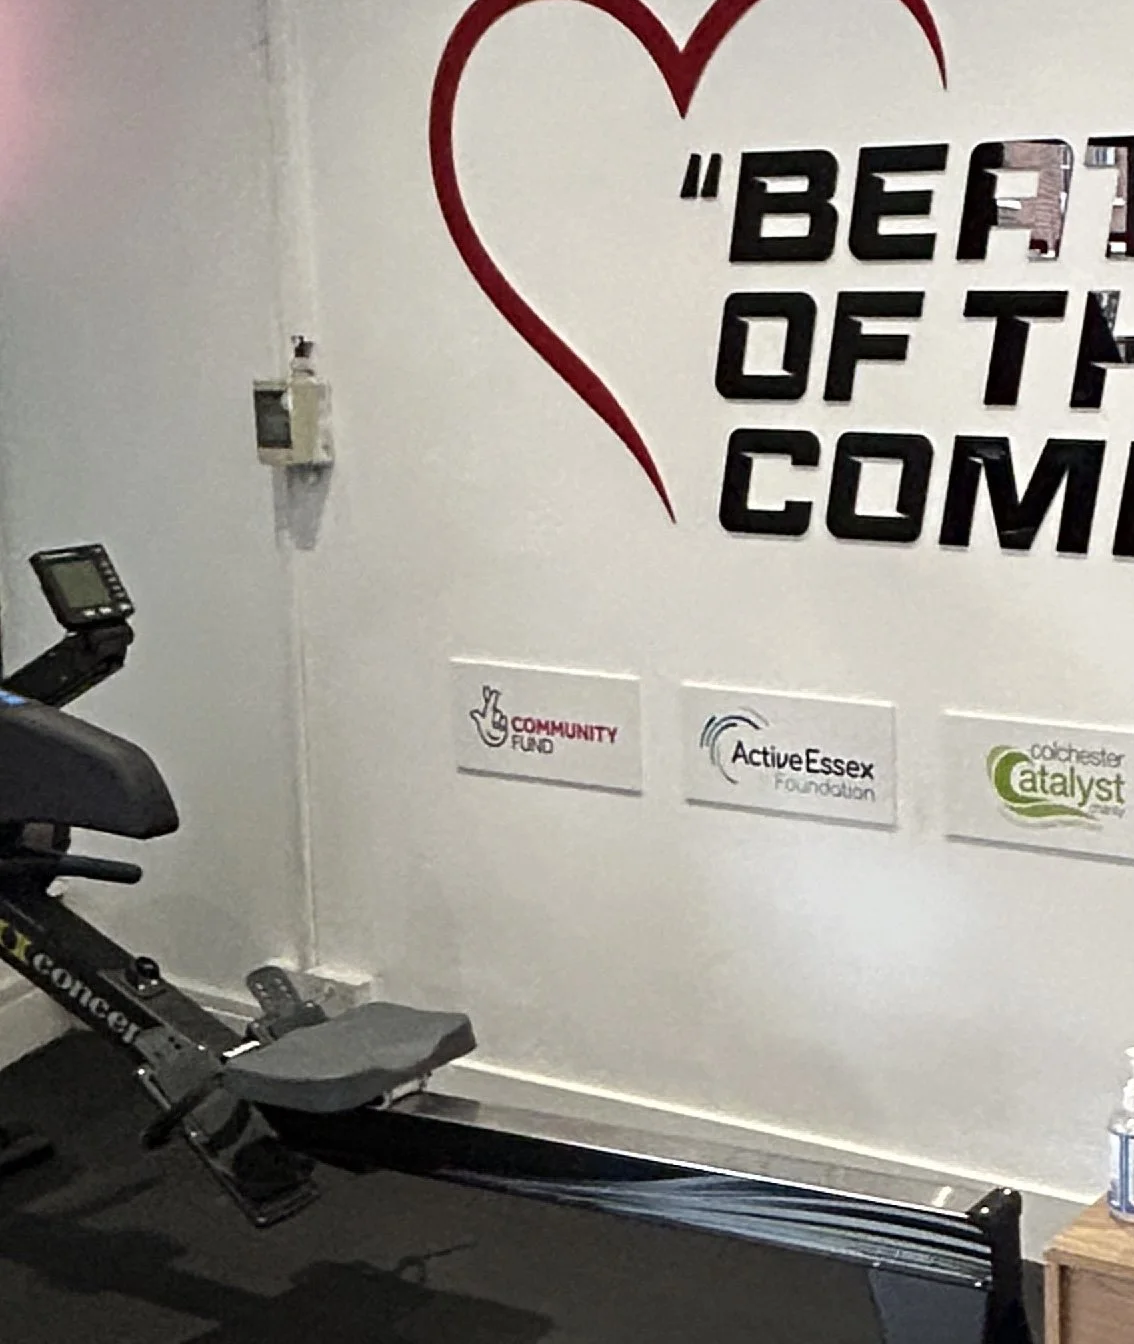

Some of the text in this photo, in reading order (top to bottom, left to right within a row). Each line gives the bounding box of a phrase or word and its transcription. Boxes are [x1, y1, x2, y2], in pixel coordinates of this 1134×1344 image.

[715, 290, 926, 403] OF
[511, 716, 618, 744] COMMUNITY
[511, 734, 554, 754] FUND
[1030, 741, 1125, 768] colchester
[774, 772, 876, 802] Foundation
